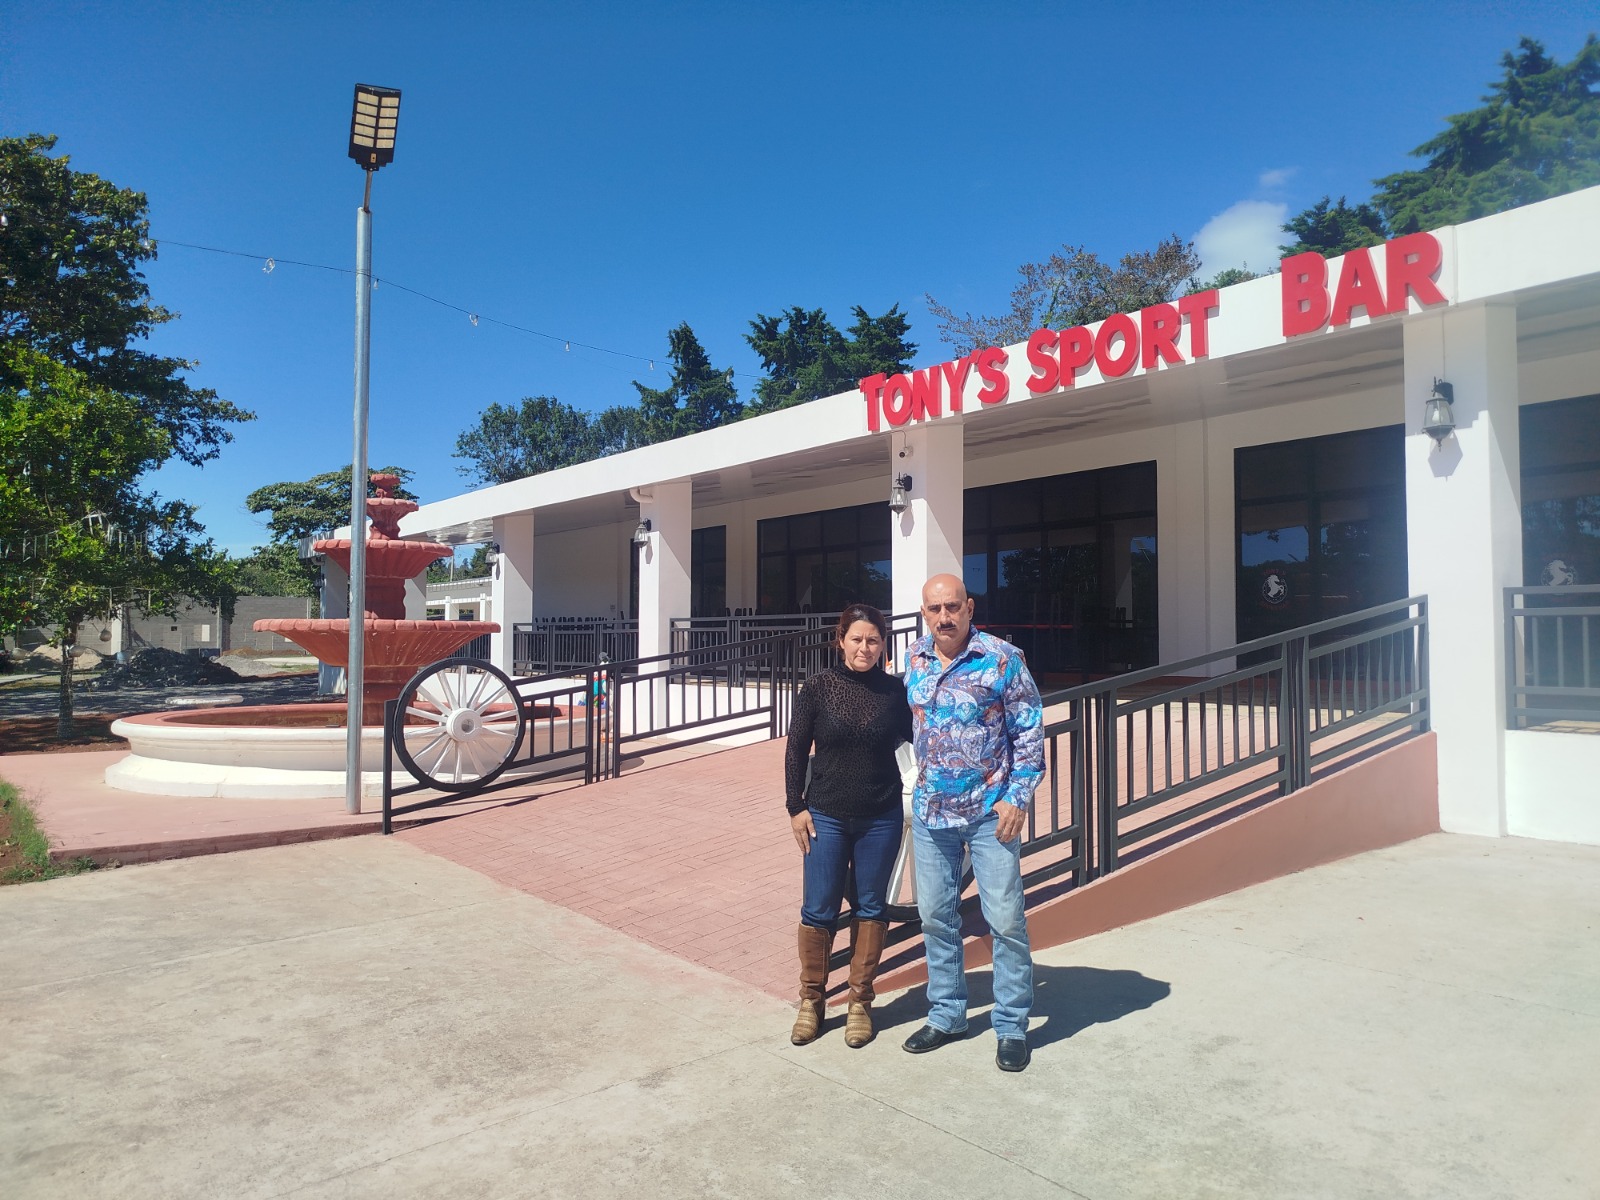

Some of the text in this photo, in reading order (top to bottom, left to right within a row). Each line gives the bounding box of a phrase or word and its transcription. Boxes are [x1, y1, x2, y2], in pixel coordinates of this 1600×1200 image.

[860, 232, 1449, 432] TONY'S SPORT BAR
